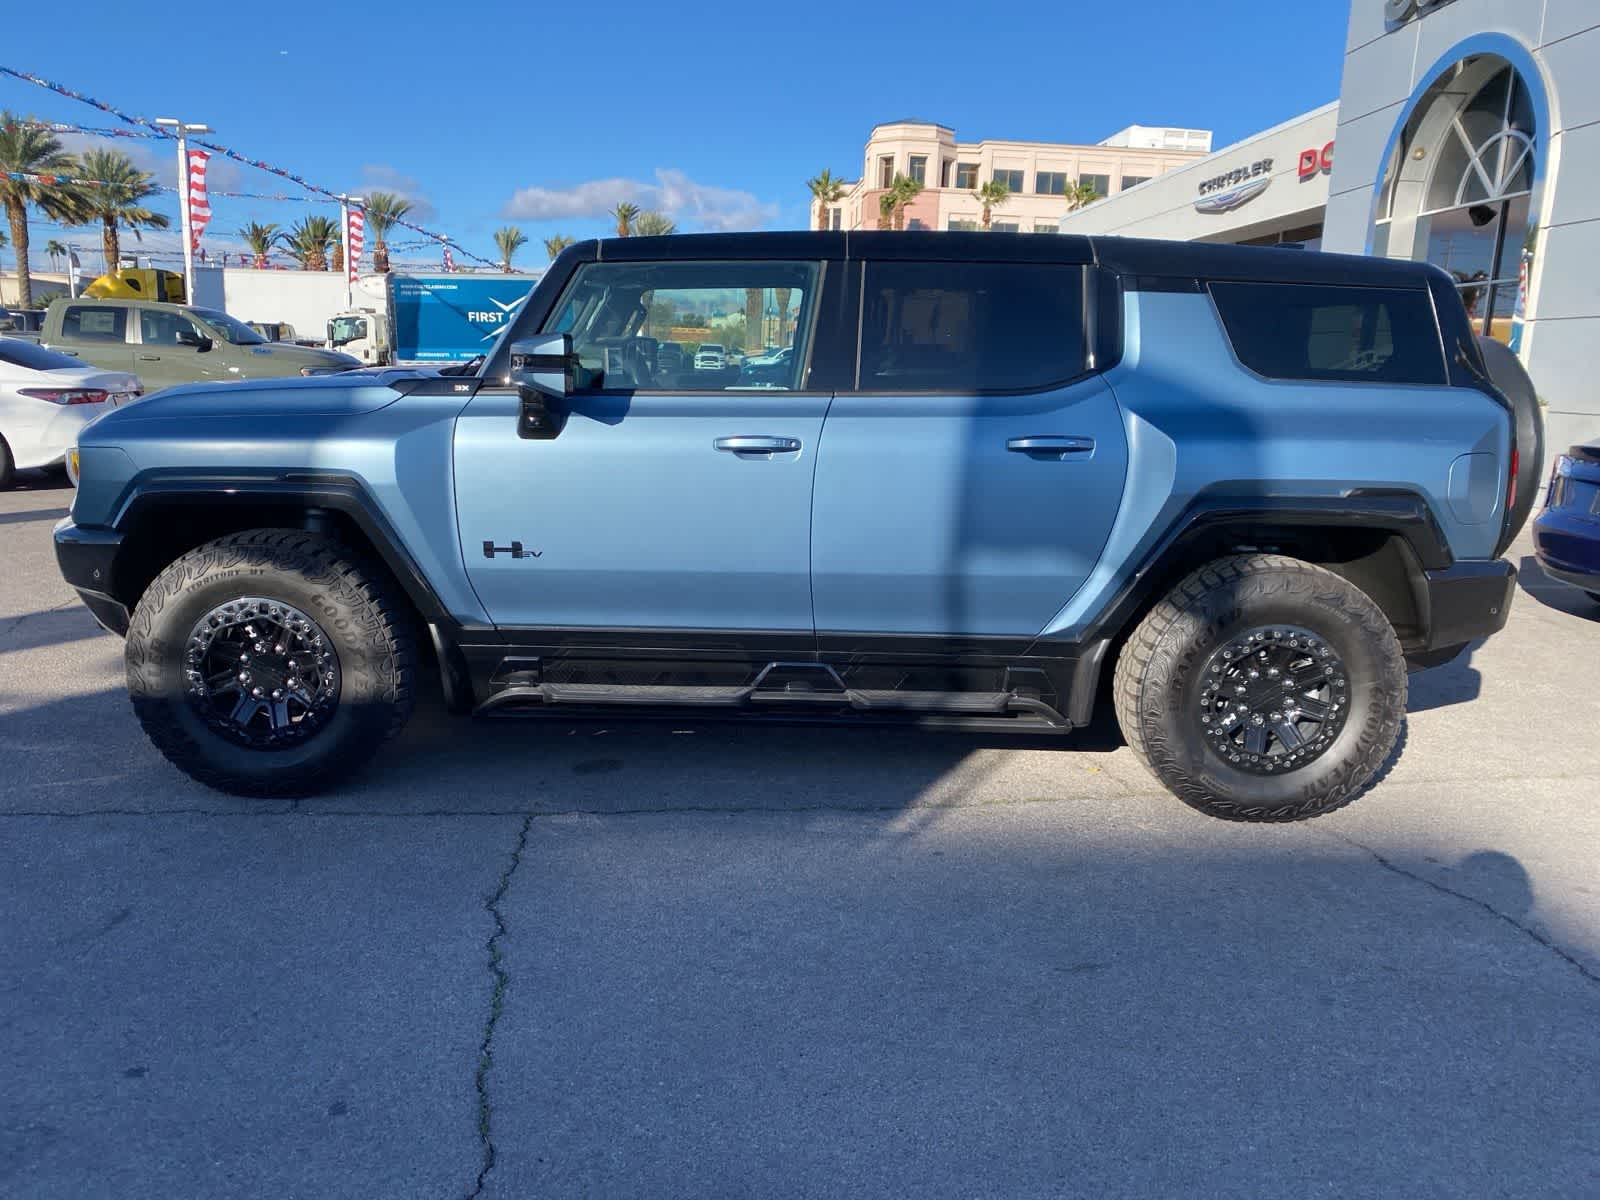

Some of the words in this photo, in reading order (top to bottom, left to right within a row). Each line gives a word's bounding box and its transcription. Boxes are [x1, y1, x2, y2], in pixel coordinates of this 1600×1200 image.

[1198, 158, 1274, 195] CHRYSLER
[468, 311, 504, 322] FIRST
[186, 569, 240, 592] TERRITORY
